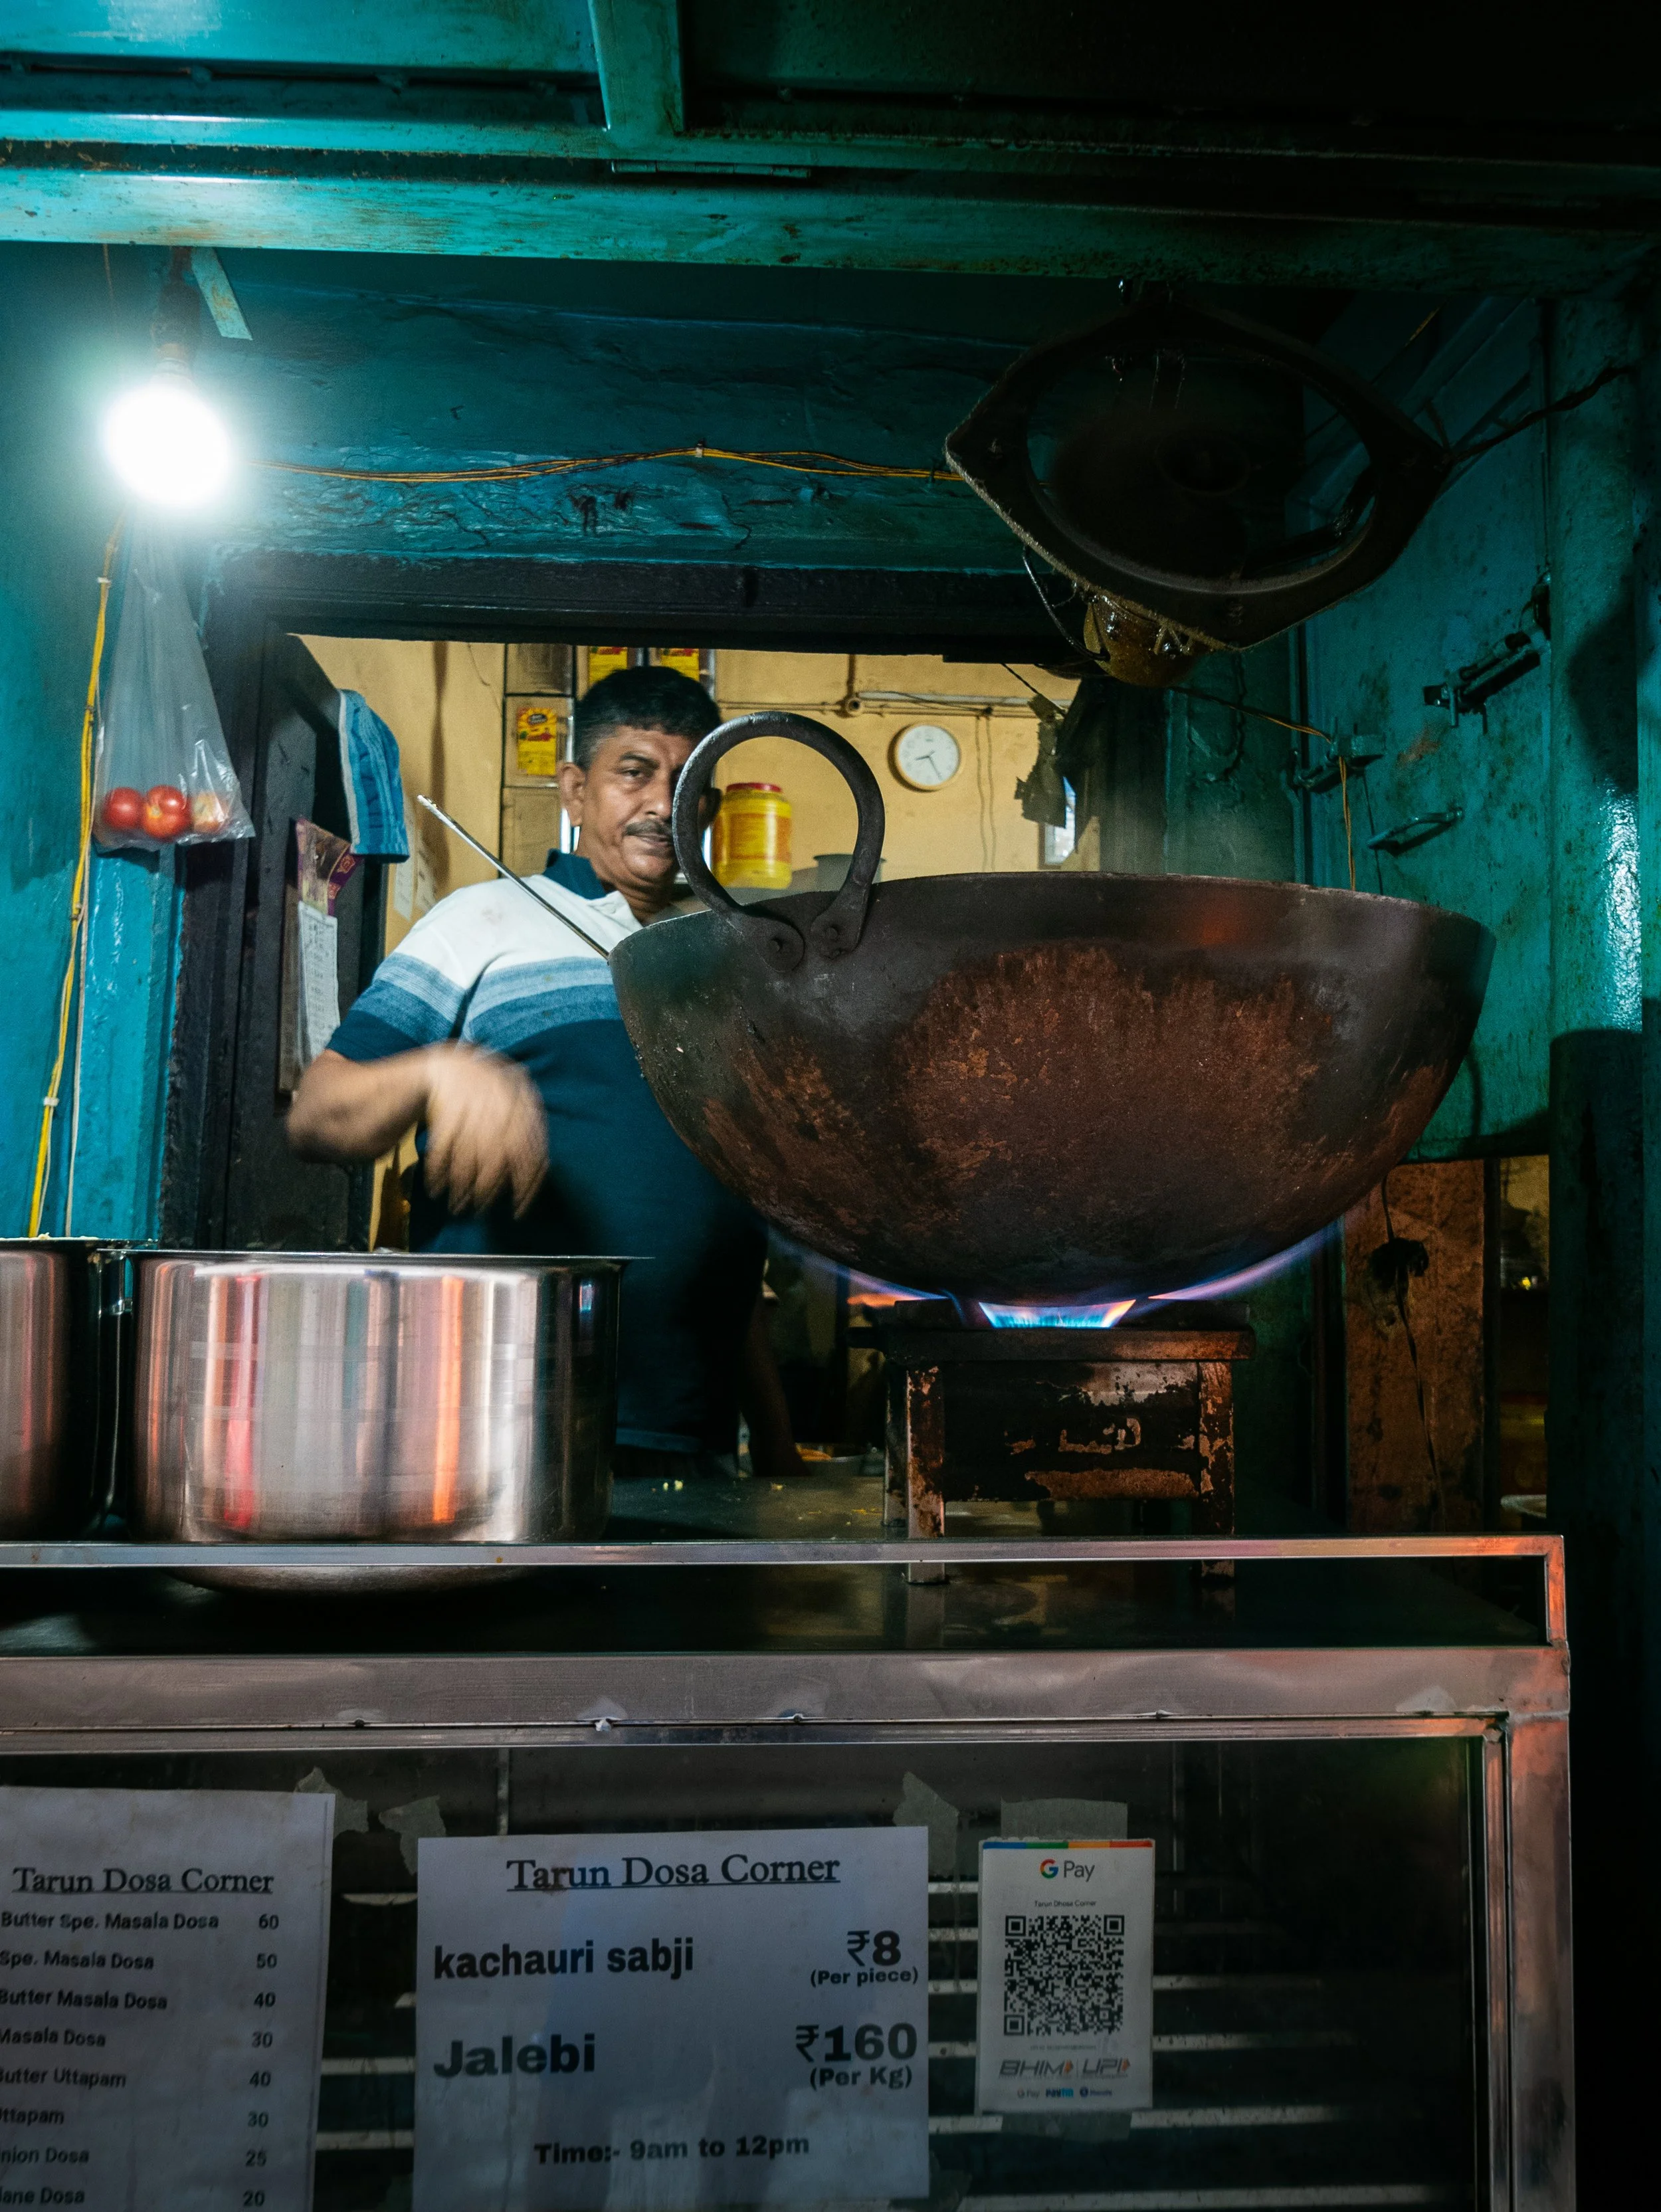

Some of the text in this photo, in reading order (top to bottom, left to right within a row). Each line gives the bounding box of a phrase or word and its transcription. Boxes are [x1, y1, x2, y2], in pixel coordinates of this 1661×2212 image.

[13, 1868, 274, 1893] Tarun Dosa Corner
[506, 1853, 840, 1892] Tarun Dosa Corner
[1040, 1859, 1095, 1882] G Pay
[1, 1911, 54, 1928] Butter
[105, 1912, 169, 1929] Masala
[174, 1914, 219, 1929] Dosa
[258, 1914, 279, 1930] 60
[44, 1950, 105, 1968] Masala
[111, 1953, 153, 1969] Dosa
[256, 1953, 277, 1969] 50
[433, 1930, 902, 1979] kachauri sabji ₹8
[810, 1967, 918, 1987] (Per piece)
[0, 1989, 276, 2009] Butter Masala Dosa 40
[64, 2029, 106, 2047] Dosa
[252, 2031, 272, 2048] 30
[433, 2022, 917, 2078] Jalebi ₹160
[54, 2067, 126, 2089] Uttapam
[250, 2071, 270, 2087] 40
[810, 2066, 912, 2090] (Per Kg)
[999, 2058, 1123, 2076] BHIM UPI
[248, 2111, 268, 2128] 30
[0, 2145, 266, 2167] nion Dosa 25
[535, 2135, 809, 2165] Time:- 9am to 12pm
[40, 2187, 84, 2205] Dosa
[243, 2190, 265, 2207] 20
